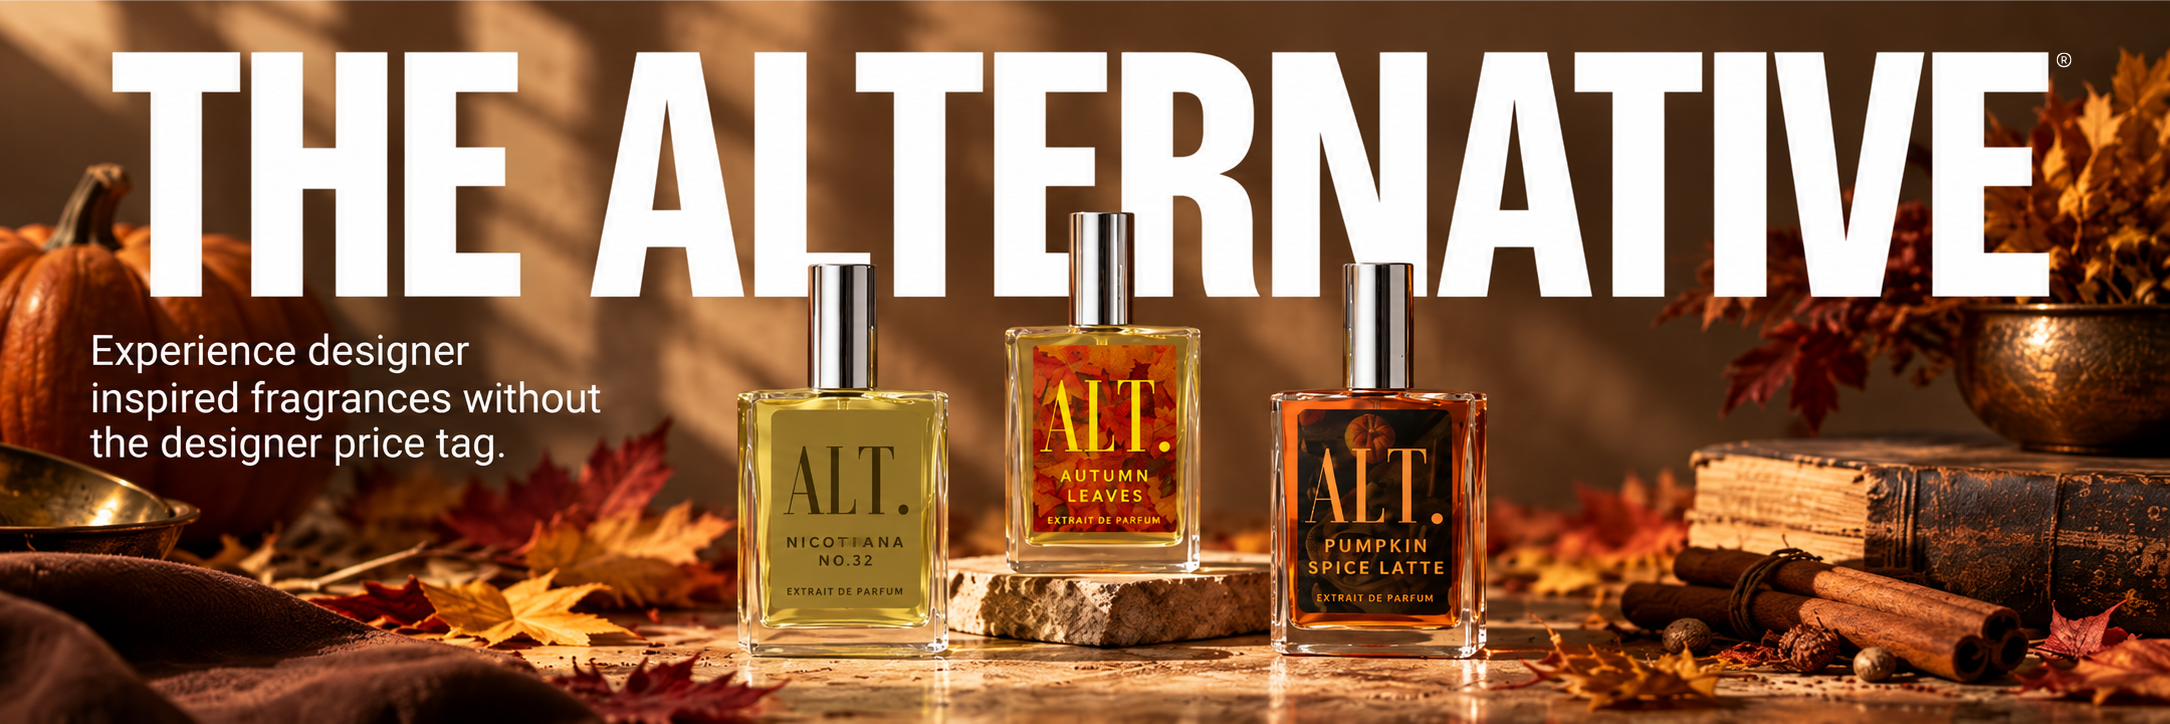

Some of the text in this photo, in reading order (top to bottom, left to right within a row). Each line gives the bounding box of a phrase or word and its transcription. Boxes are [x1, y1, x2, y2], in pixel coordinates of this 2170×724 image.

[1039, 379, 1171, 453] ALT.
[783, 445, 910, 515] ALT.
[1060, 469, 1148, 482] AUTUMN
[1304, 447, 1444, 525] ALT.
[1067, 489, 1143, 503] LEAVES
[1047, 516, 1161, 525] EXTRAIT DE PARFUM
[1324, 538, 1427, 553] PUMPKIN
[818, 554, 873, 566] NO.32
[1308, 560, 1445, 575] SPICE LATTE
[786, 587, 904, 596] EXTRAIT DE PARFUM
[1316, 593, 1434, 603] EXTRAIT DE PARFUM
